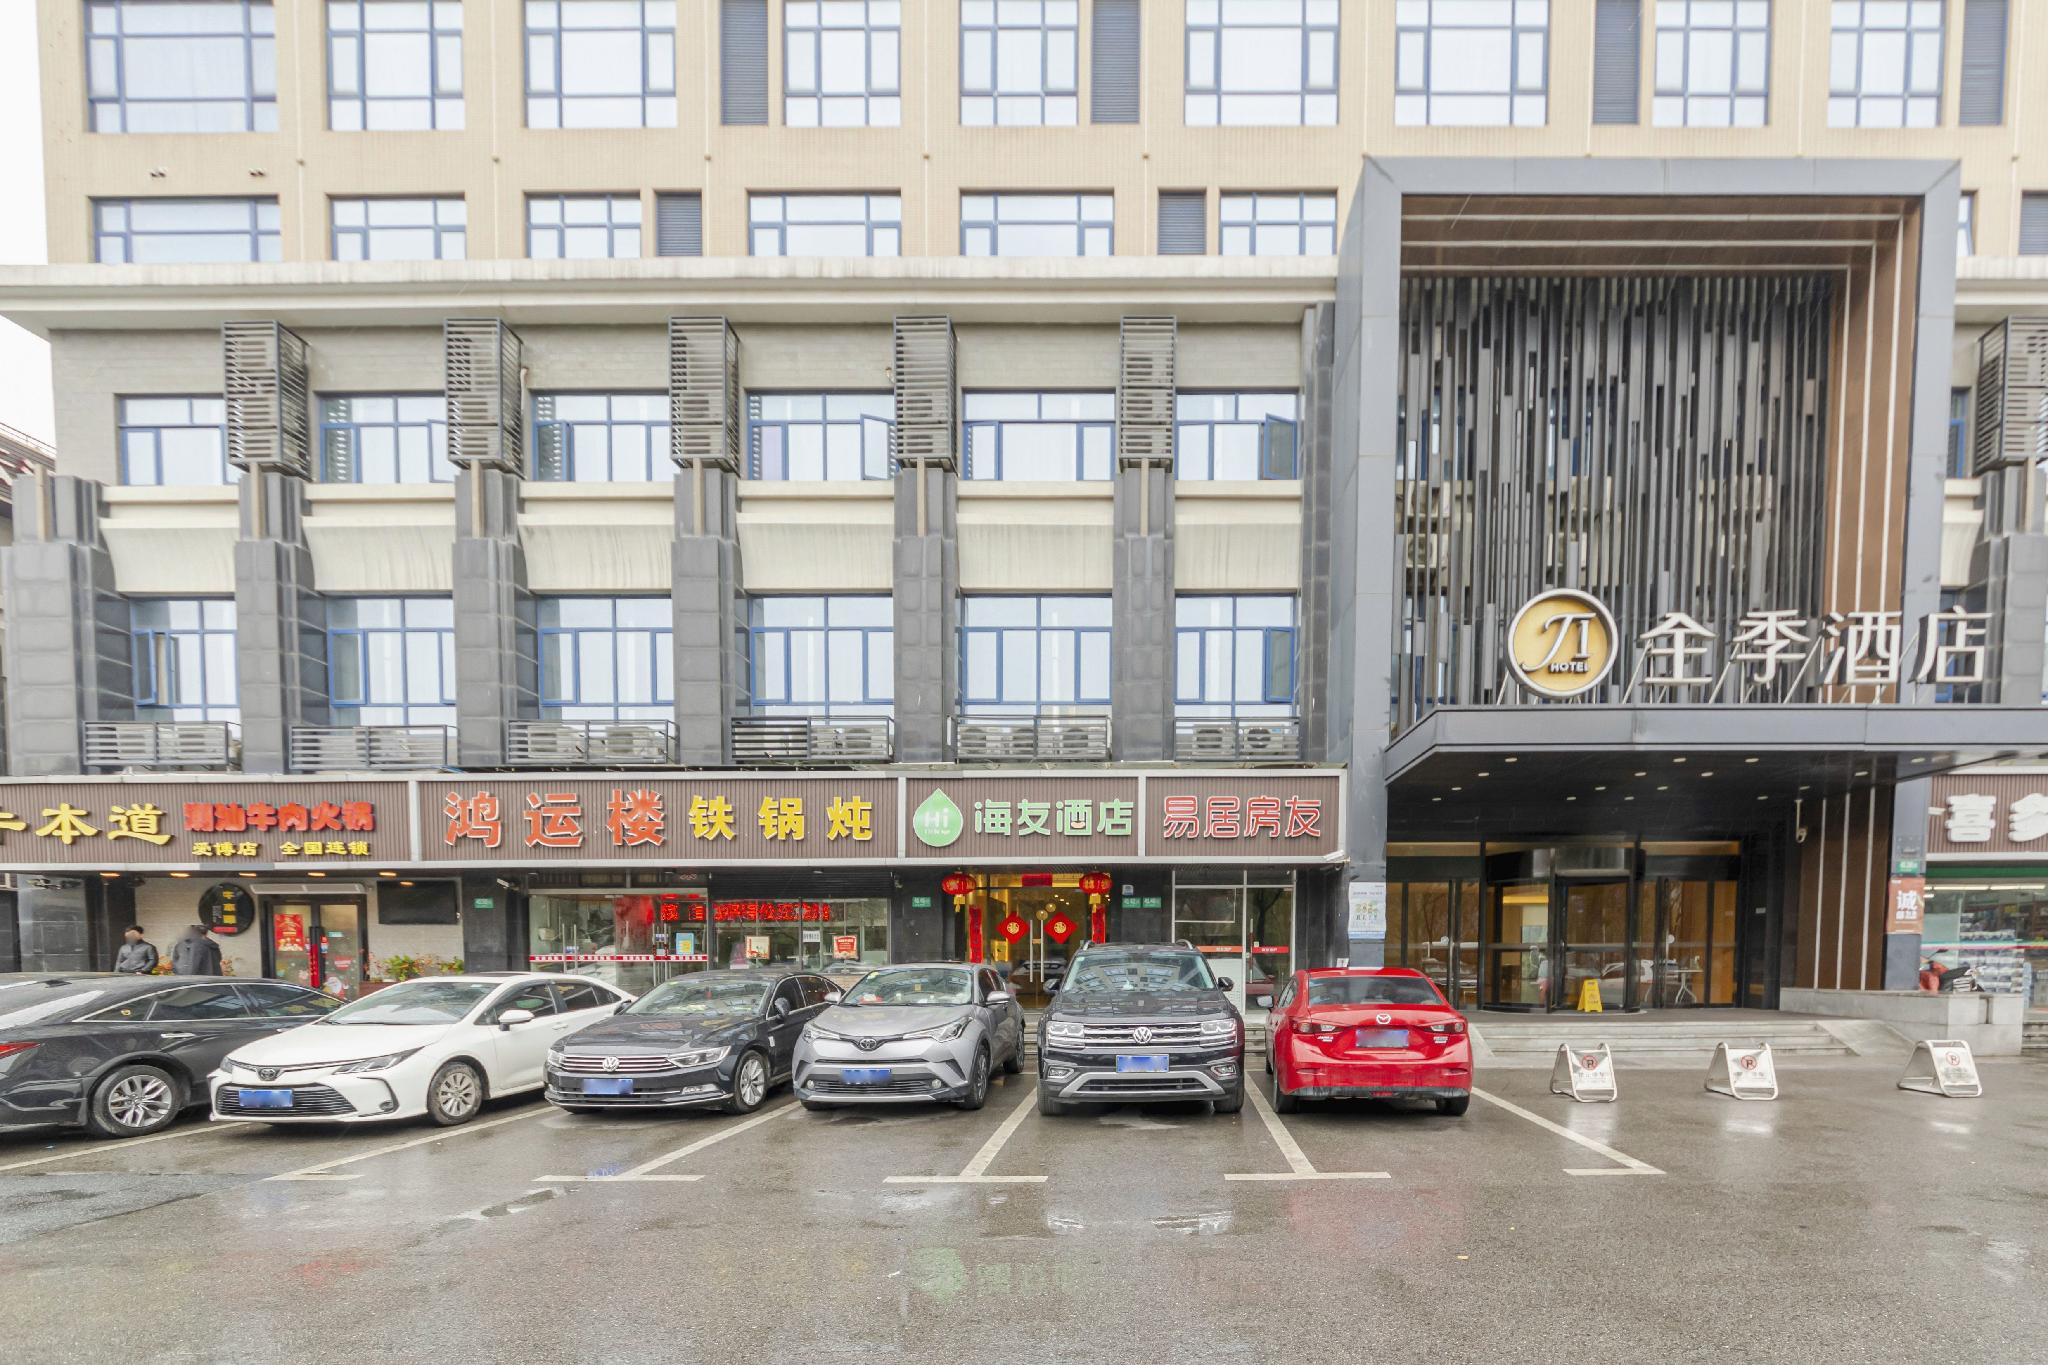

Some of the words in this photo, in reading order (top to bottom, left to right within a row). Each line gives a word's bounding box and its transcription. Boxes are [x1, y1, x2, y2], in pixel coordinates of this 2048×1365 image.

[1639, 606, 1994, 685] 全季酒店
[1550, 661, 1588, 673] HOTEL
[183, 801, 374, 832] 潮汕牛肉火锅
[443, 789, 666, 848] 鸿运楼
[688, 795, 874, 842] 铁锅炖
[923, 807, 949, 829] Hi
[974, 798, 1134, 836] 海友酒店
[1163, 795, 1322, 839] 易居房友
[280, 841, 370, 857] 全国连锁
